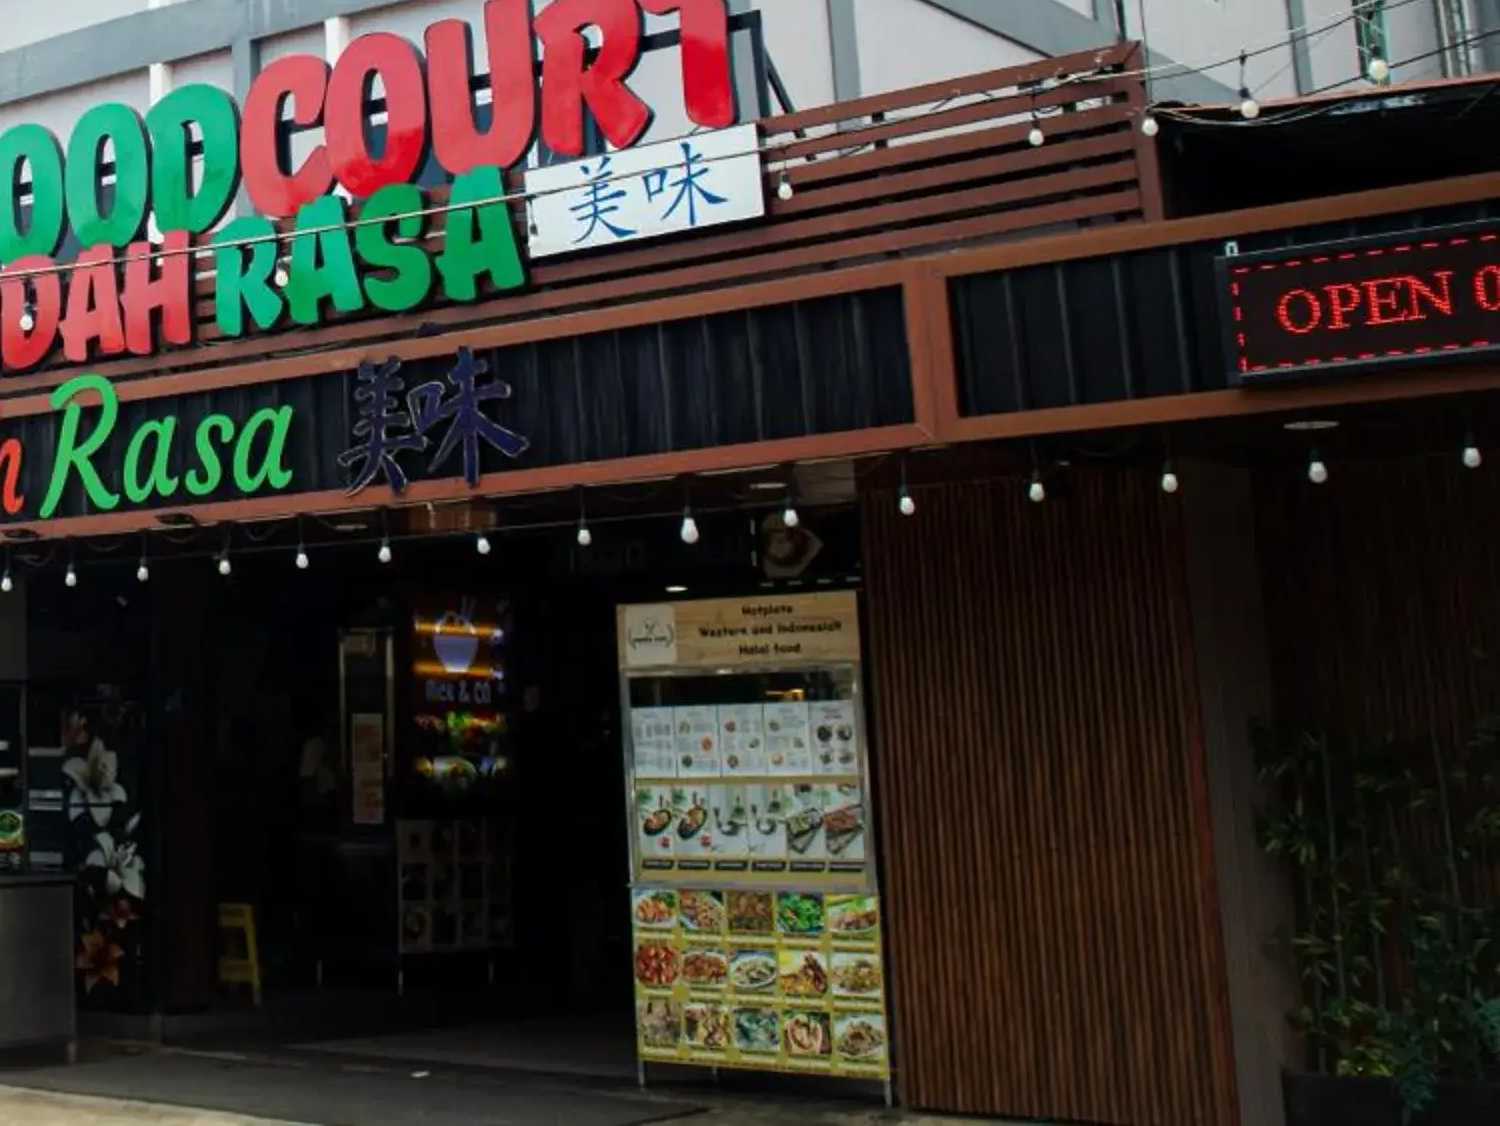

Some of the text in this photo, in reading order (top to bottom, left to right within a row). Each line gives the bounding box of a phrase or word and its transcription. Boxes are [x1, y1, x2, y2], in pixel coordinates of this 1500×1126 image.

[213, 165, 525, 336] RASA
[569, 143, 728, 244] 美味
[1275, 271, 1453, 334] OPEN
[40, 374, 293, 518] Rasa
[336, 345, 530, 498] 美味
[773, 642, 801, 654] food
